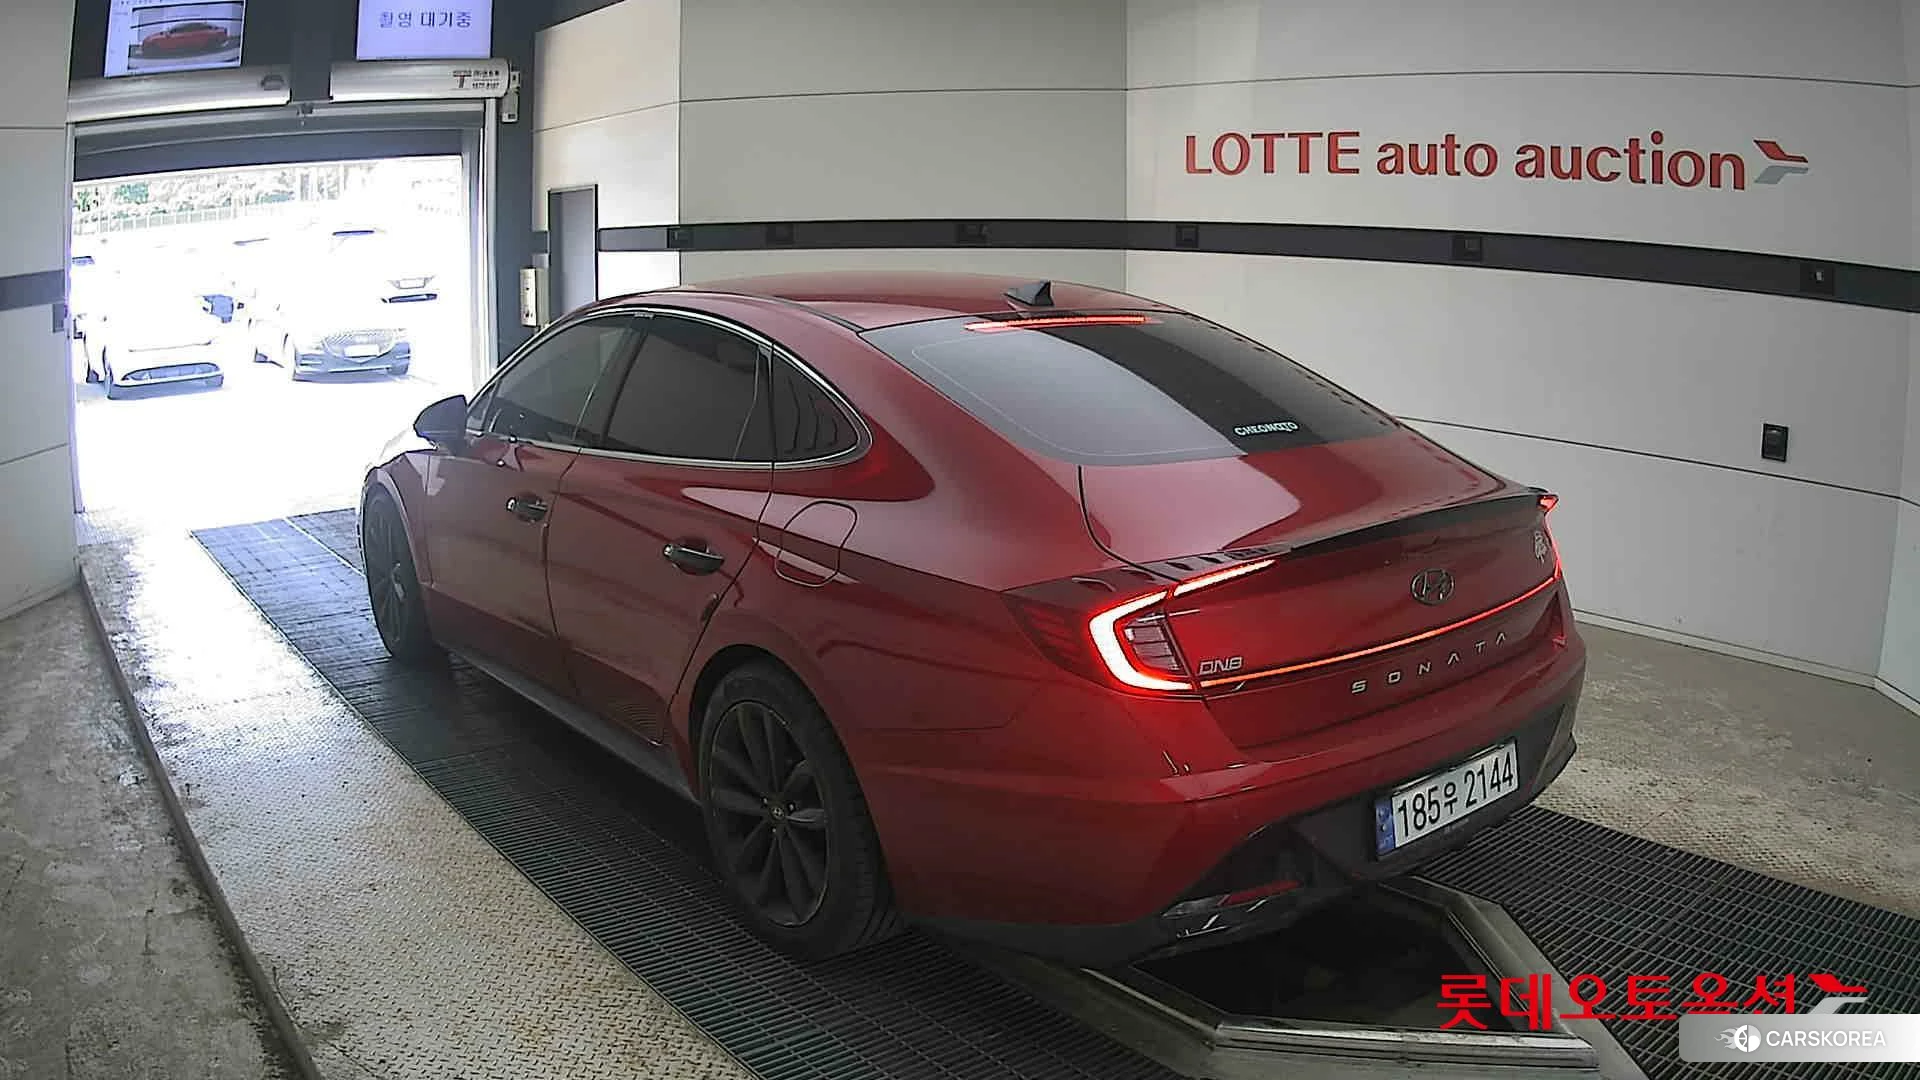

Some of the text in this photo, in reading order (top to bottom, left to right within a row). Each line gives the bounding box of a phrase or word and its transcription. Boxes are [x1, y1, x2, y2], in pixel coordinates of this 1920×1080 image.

[421, 11, 471, 28] 대기중
[1185, 130, 1745, 190] LOTTE auto auction
[1351, 632, 1507, 693] SONATA
[1397, 751, 1514, 837] 185우 2144
